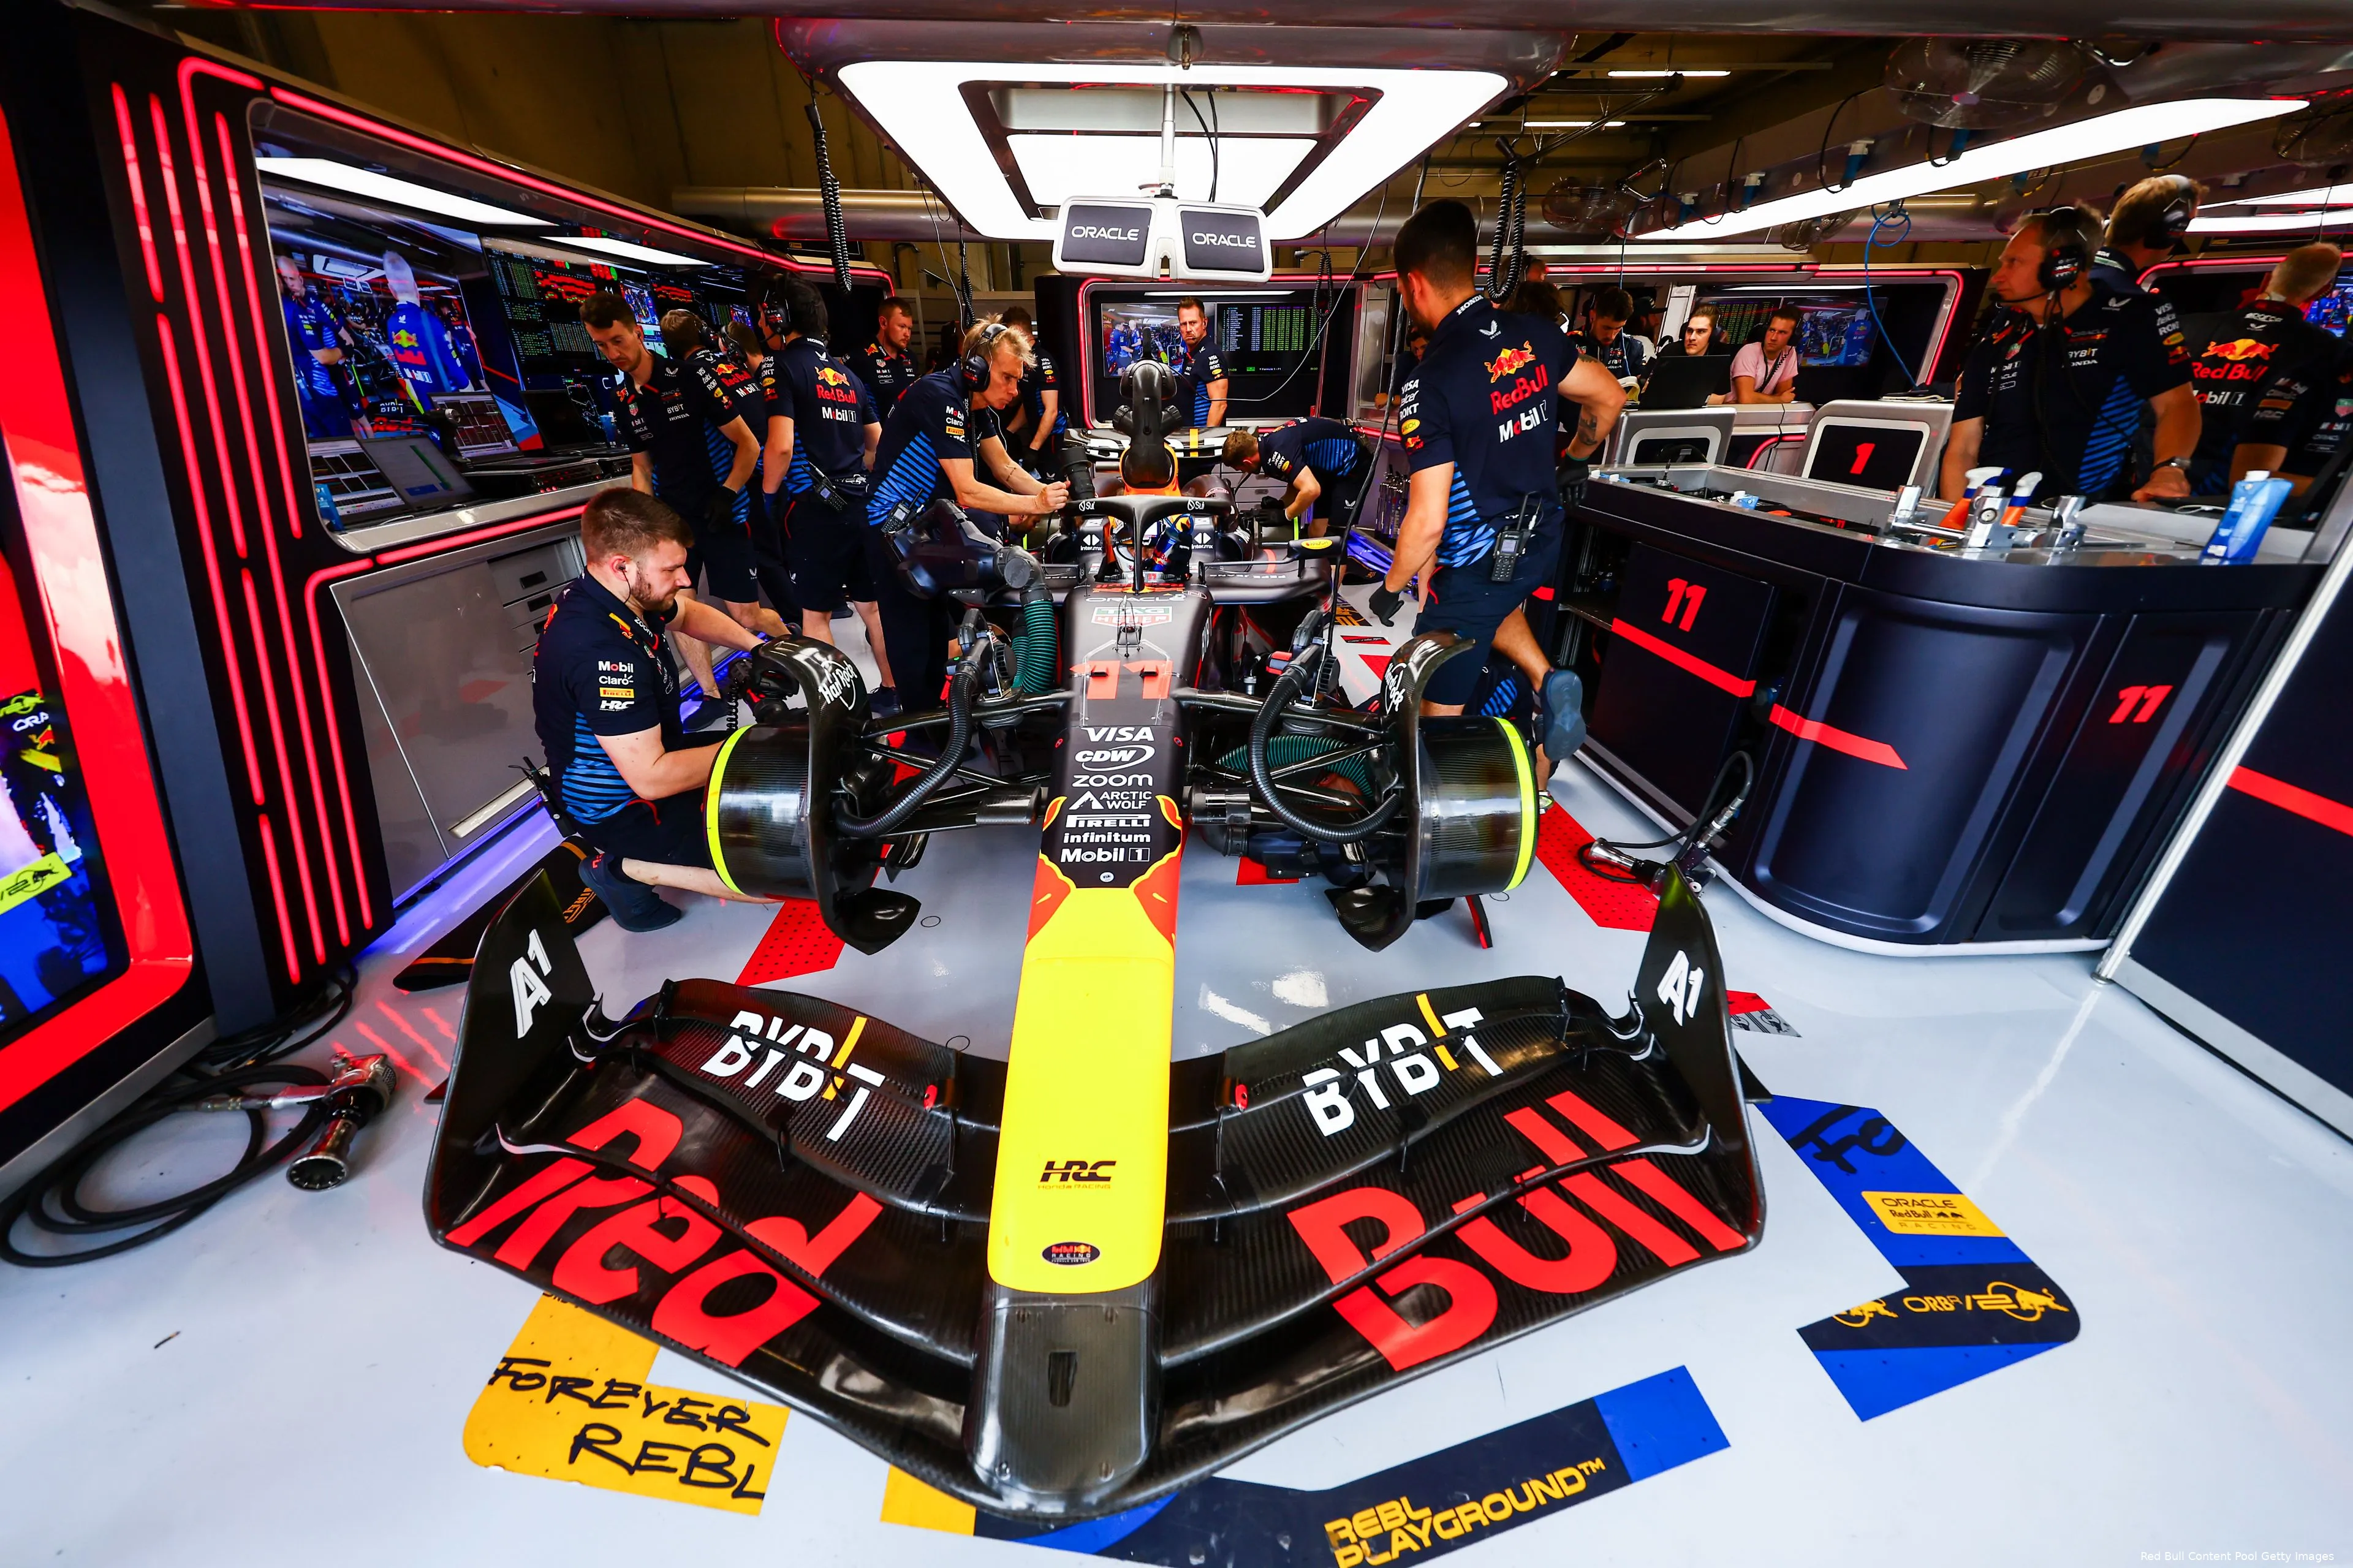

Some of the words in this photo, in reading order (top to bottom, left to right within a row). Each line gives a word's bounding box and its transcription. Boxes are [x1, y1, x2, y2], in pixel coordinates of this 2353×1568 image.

[1072, 225, 1139, 241] ORACLE
[1192, 232, 1256, 248] ORACLE
[1456, 295, 1484, 316] HONDA
[2155, 303, 2173, 316] VIS
[2244, 312, 2284, 322] sparco
[806, 338, 825, 347] HONDA
[2192, 362, 2230, 379] Red
[2227, 363, 2269, 382] Bull
[736, 383, 755, 398] Mobil
[816, 384, 836, 401] Red
[836, 388, 857, 404] Bull
[1401, 379, 1420, 395] VISA
[1490, 382, 1524, 415] Red
[1515, 363, 1548, 399] Bull
[667, 403, 684, 414] BYBIT
[822, 406, 848, 422] Mobil
[669, 413, 690, 422] HONDA
[946, 417, 964, 427] Claro
[1499, 407, 1541, 444] Mobil
[1851, 443, 1875, 474] 1
[1085, 501, 1095, 510] Sui
[1195, 502, 1205, 510] Sui
[1661, 577, 1707, 632] 11
[634, 616, 653, 637] zoom
[598, 661, 634, 673] Mobil
[599, 675, 631, 686] Claro
[818, 670, 843, 705] Hard
[835, 660, 858, 688] Rock
[1069, 661, 1173, 700] 11
[600, 700, 635, 710] HRC
[2108, 684, 2173, 724] 11
[1080, 727, 1155, 743] VISA
[1075, 749, 1137, 763] CDW
[1072, 774, 1153, 787] zoom
[1099, 791, 1153, 800] ARCTIC
[1106, 800, 1148, 809] WOLF
[1066, 814, 1152, 828] PIRELLI
[1063, 831, 1151, 844] infinitum
[1060, 847, 1125, 863] Mobil
[509, 929, 553, 1039] A1
[1656, 949, 1705, 1027] A1
[1301, 993, 1504, 1137] BYBIT
[700, 1010, 886, 1143] BYBIT
[1040, 1161, 1117, 1183] HRC
[1881, 1198, 1958, 1209] ORACLE
[1889, 1209, 1912, 1218] Red
[1911, 1210, 1933, 1219] Bull
[443, 1098, 884, 1368] Red
[1287, 1090, 1748, 1373] Bull
[1898, 1222, 1977, 1230] RACING
[487, 1356, 771, 1448] FOREVER
[569, 1423, 765, 1501] REBL
[1324, 1496, 1433, 1544] REBL
